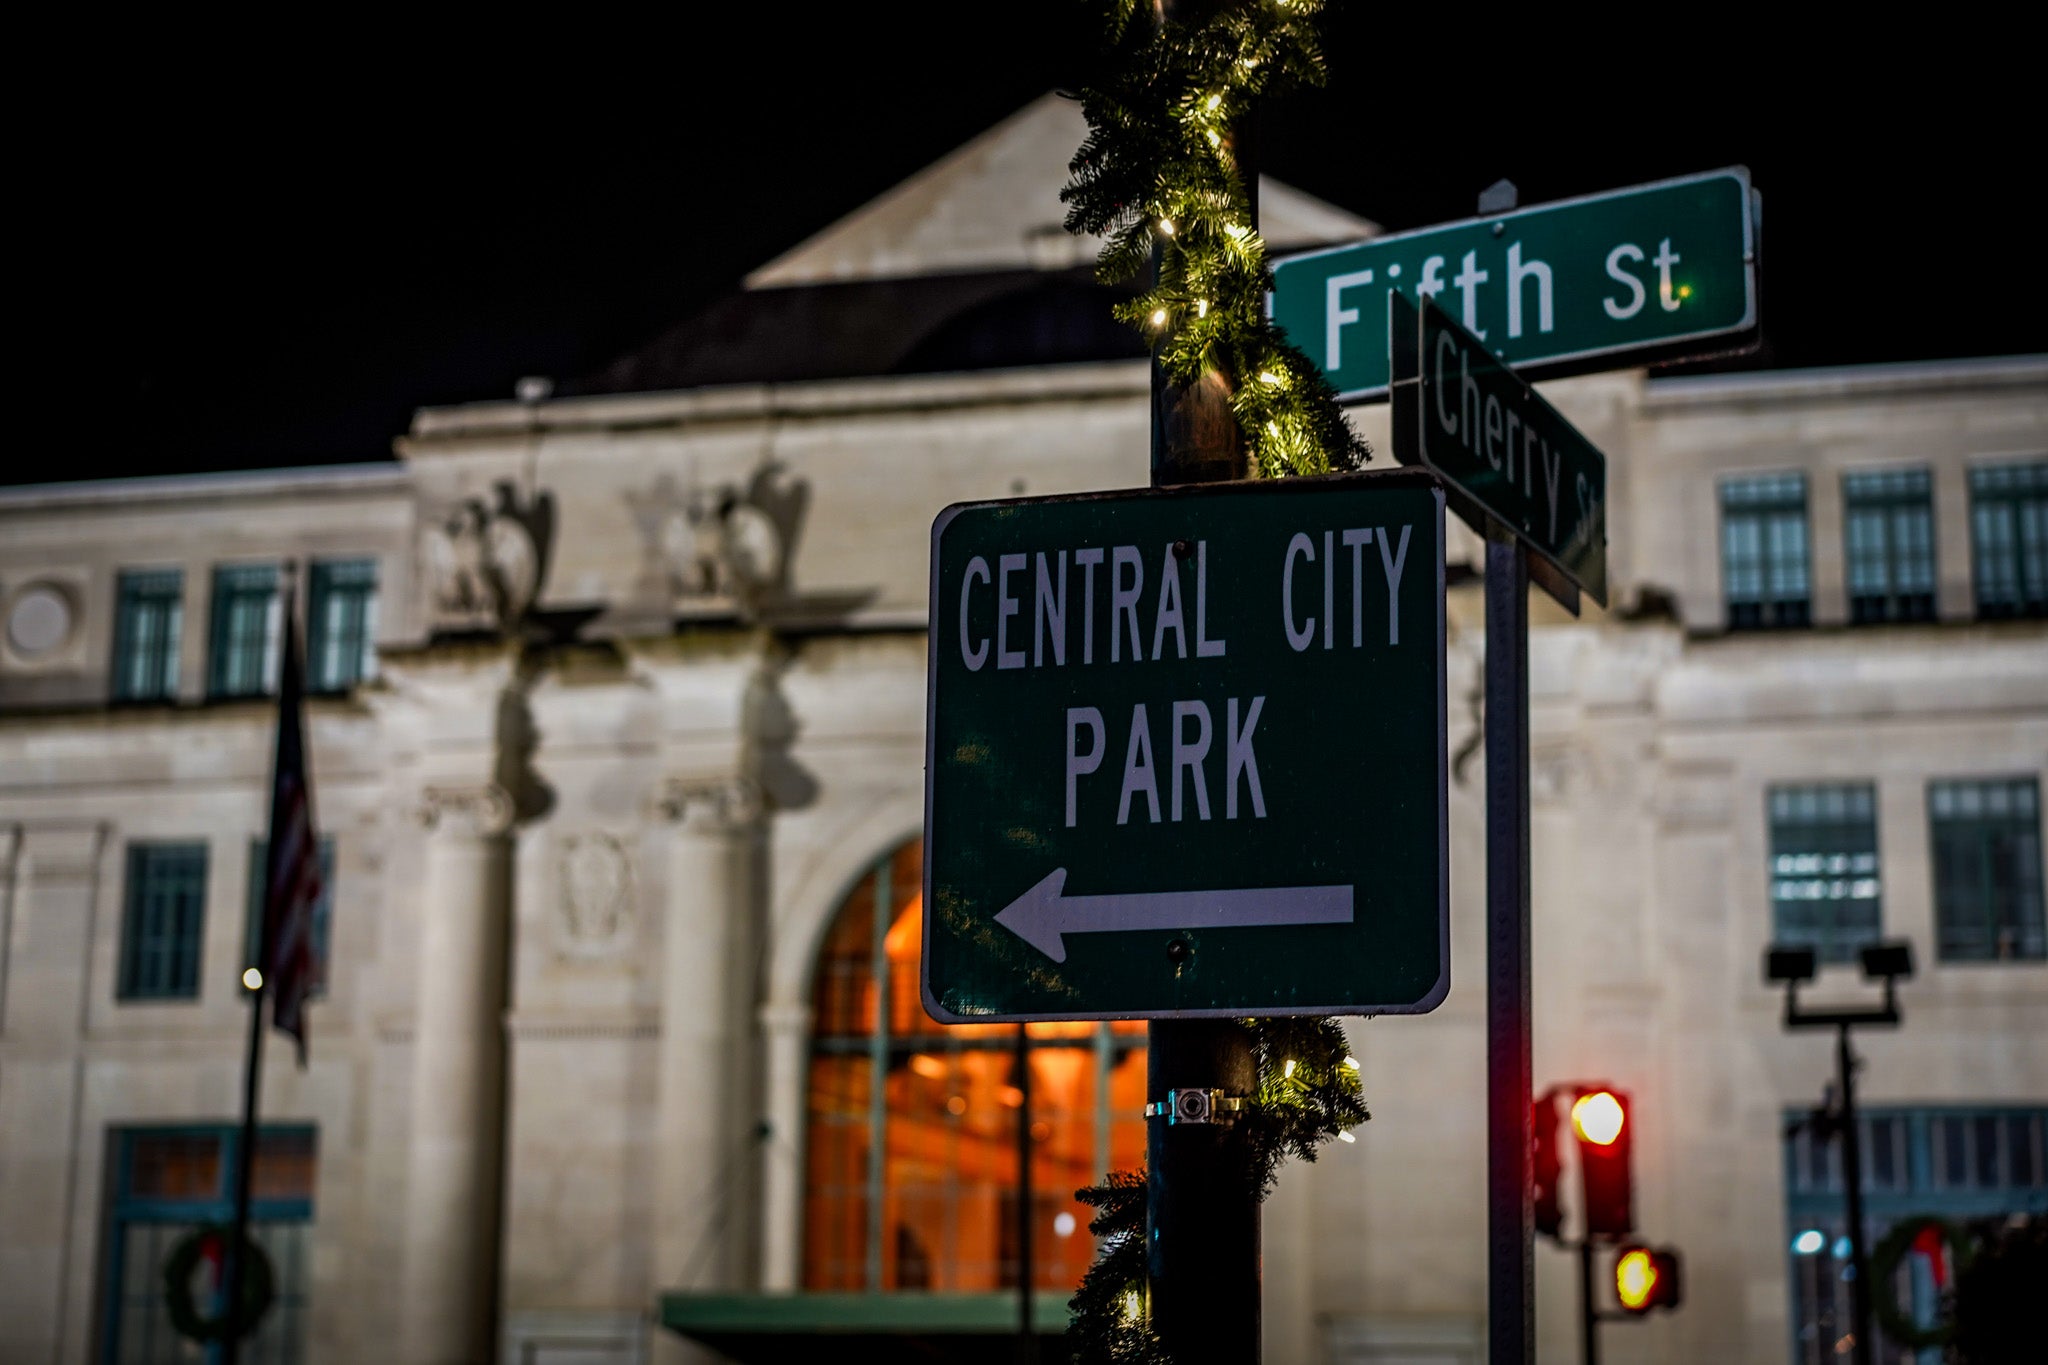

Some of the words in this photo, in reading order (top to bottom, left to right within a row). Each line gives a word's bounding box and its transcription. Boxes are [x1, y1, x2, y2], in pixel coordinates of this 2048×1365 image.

[1603, 238, 1681, 320] St
[1435, 329, 1561, 547] Cherry
[959, 541, 1226, 672] CENTRAL
[1283, 525, 1412, 652] CITY
[1065, 695, 1267, 827] PARK
